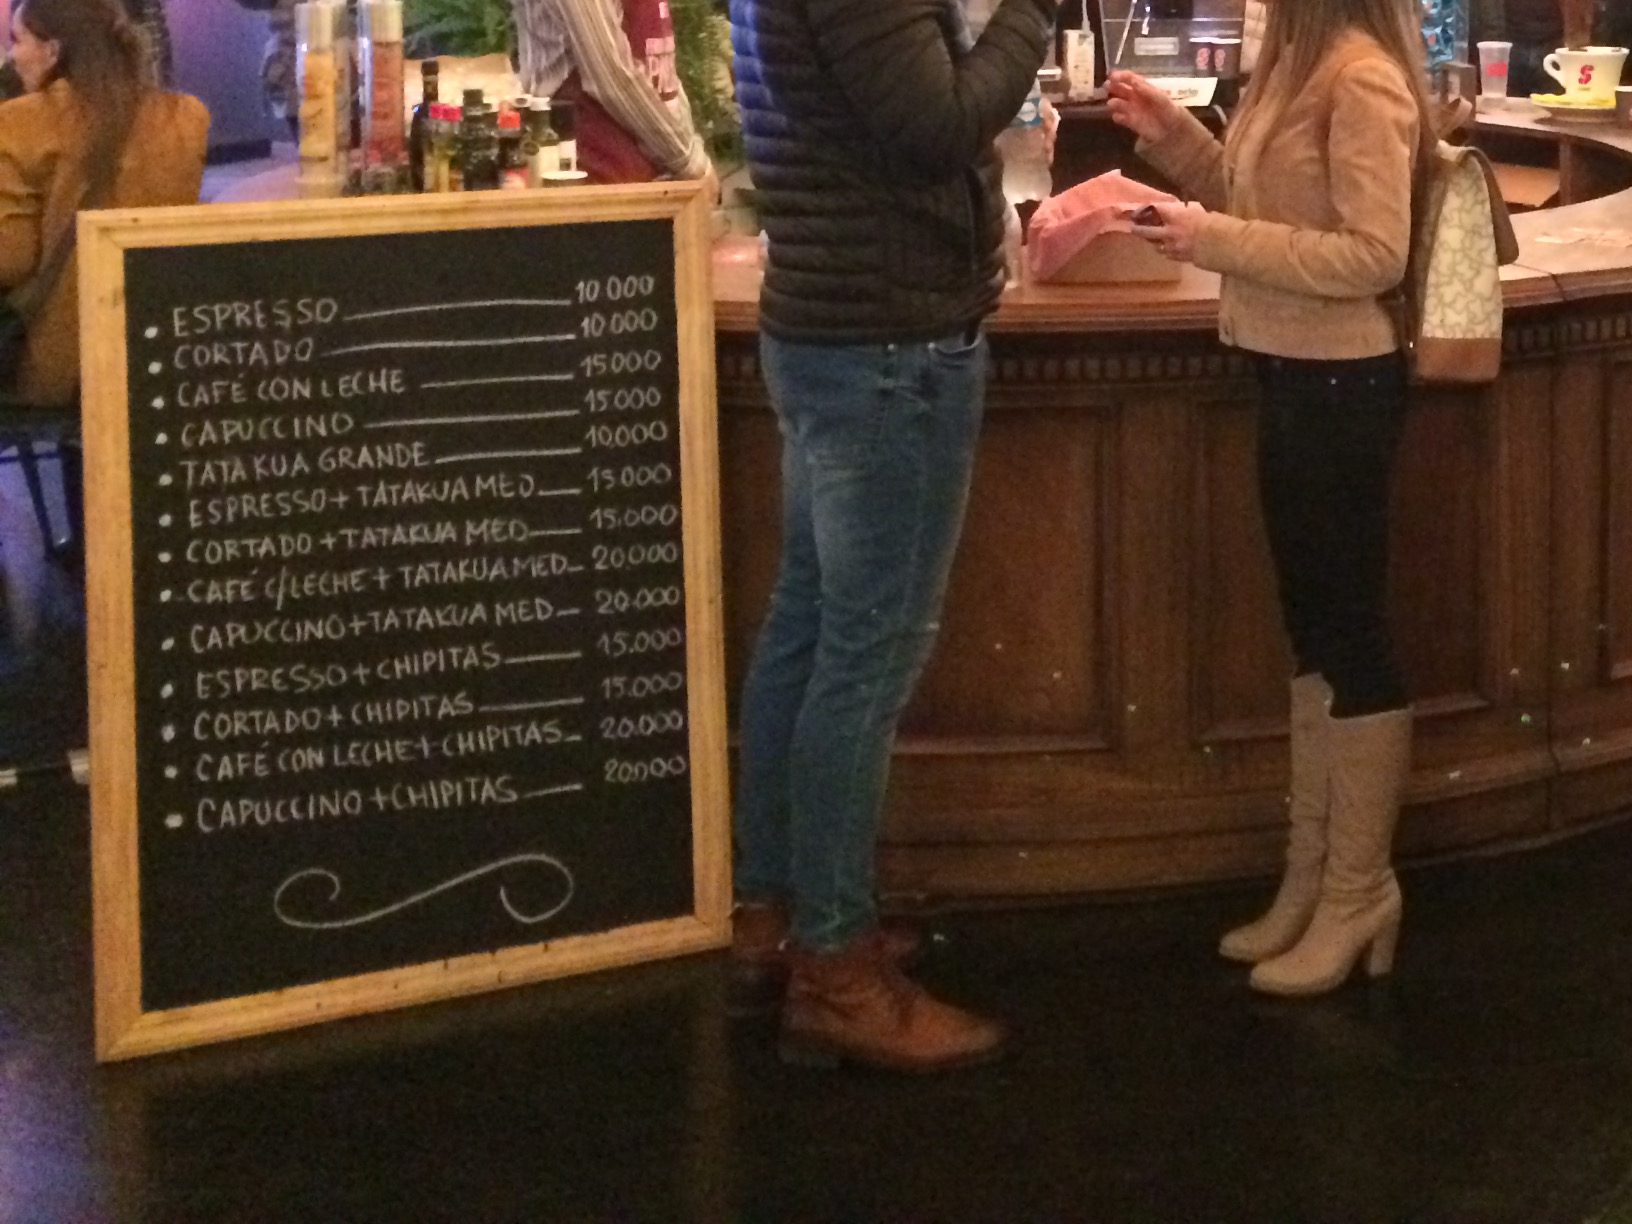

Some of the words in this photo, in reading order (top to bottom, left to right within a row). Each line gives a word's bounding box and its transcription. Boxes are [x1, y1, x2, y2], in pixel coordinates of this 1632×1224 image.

[173, 297, 339, 338] ESPRESSO
[174, 337, 315, 370] CORTADO
[257, 377, 312, 401] CON
[321, 368, 406, 398] LECHE
[181, 411, 355, 447] CAPUCCINO
[178, 452, 310, 489] TATAKUA
[318, 440, 429, 473] GRANDE
[186, 533, 312, 565] CORTADO
[190, 613, 347, 654] CAPUCCINO
[197, 663, 348, 700] ESPRESSO
[376, 640, 502, 680] CHIPITAS
[193, 706, 322, 741] CORTADO
[351, 691, 474, 725] CHIPITAS
[278, 747, 325, 773] CON
[333, 738, 415, 767] LECHE
[442, 718, 563, 757] CHIPITAS
[197, 789, 363, 834] CAPUCCINO
[391, 775, 518, 810] CHIPITAS
